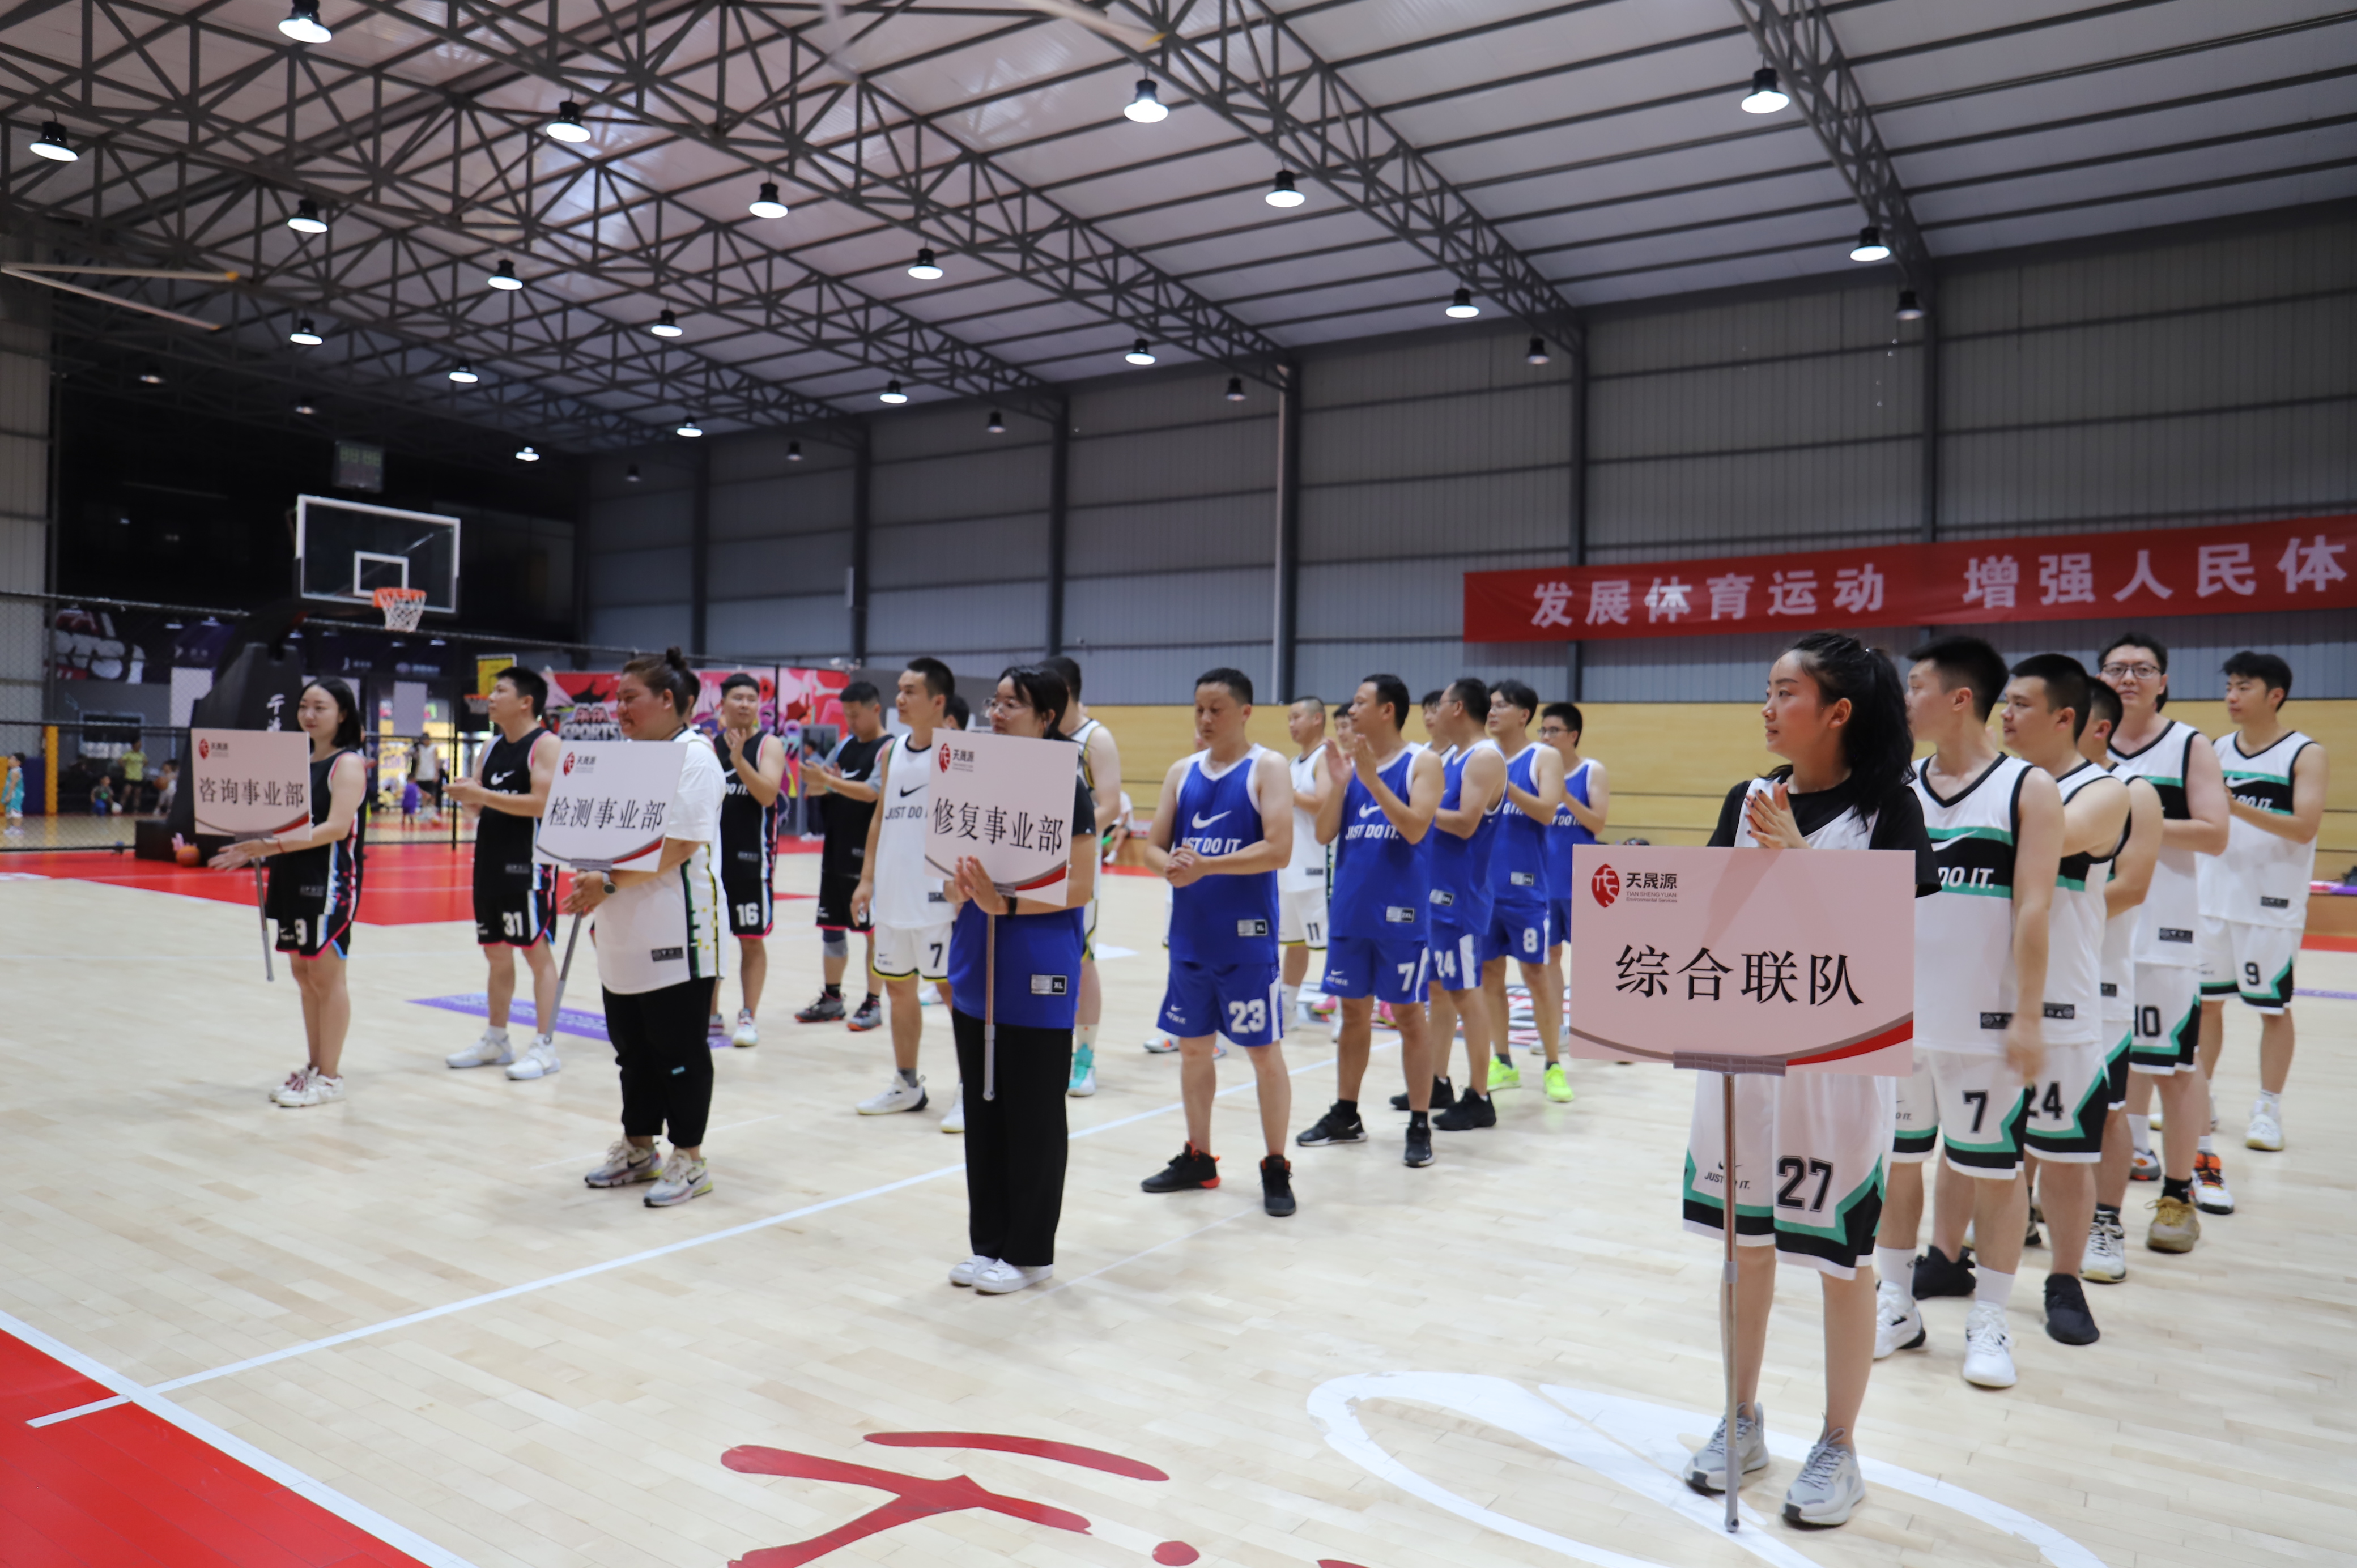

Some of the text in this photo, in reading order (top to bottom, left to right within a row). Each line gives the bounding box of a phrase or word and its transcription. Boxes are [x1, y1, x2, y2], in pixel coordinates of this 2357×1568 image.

[1531, 535, 2347, 628] 发展体育运动 增强人民体
[199, 777, 304, 807] 咨询事业部
[548, 797, 666, 831] 检测事业部
[907, 806, 923, 819] DO
[933, 797, 1063, 855] 修复事业部
[1364, 824, 1384, 839] DO
[1201, 837, 1222, 854] DO
[1626, 872, 1678, 890] 天晟源
[1938, 866, 1994, 889] DO IT.
[502, 911, 523, 936] 31
[736, 902, 759, 927] 16
[1307, 922, 1320, 941] 11
[1523, 927, 1538, 953] 8
[930, 943, 943, 969] 7
[1434, 949, 1456, 978] 24
[1397, 962, 1415, 992] 7
[1615, 944, 1864, 1007] 综合联队
[2244, 961, 2261, 986] 9
[1228, 998, 1266, 1033] 23
[2134, 1004, 2161, 1037] 10
[1962, 1089, 1988, 1134] 7
[1704, 1171, 1724, 1184] JUST
[1739, 1180, 1751, 1190] IT.
[1776, 1154, 1833, 1212] 27
